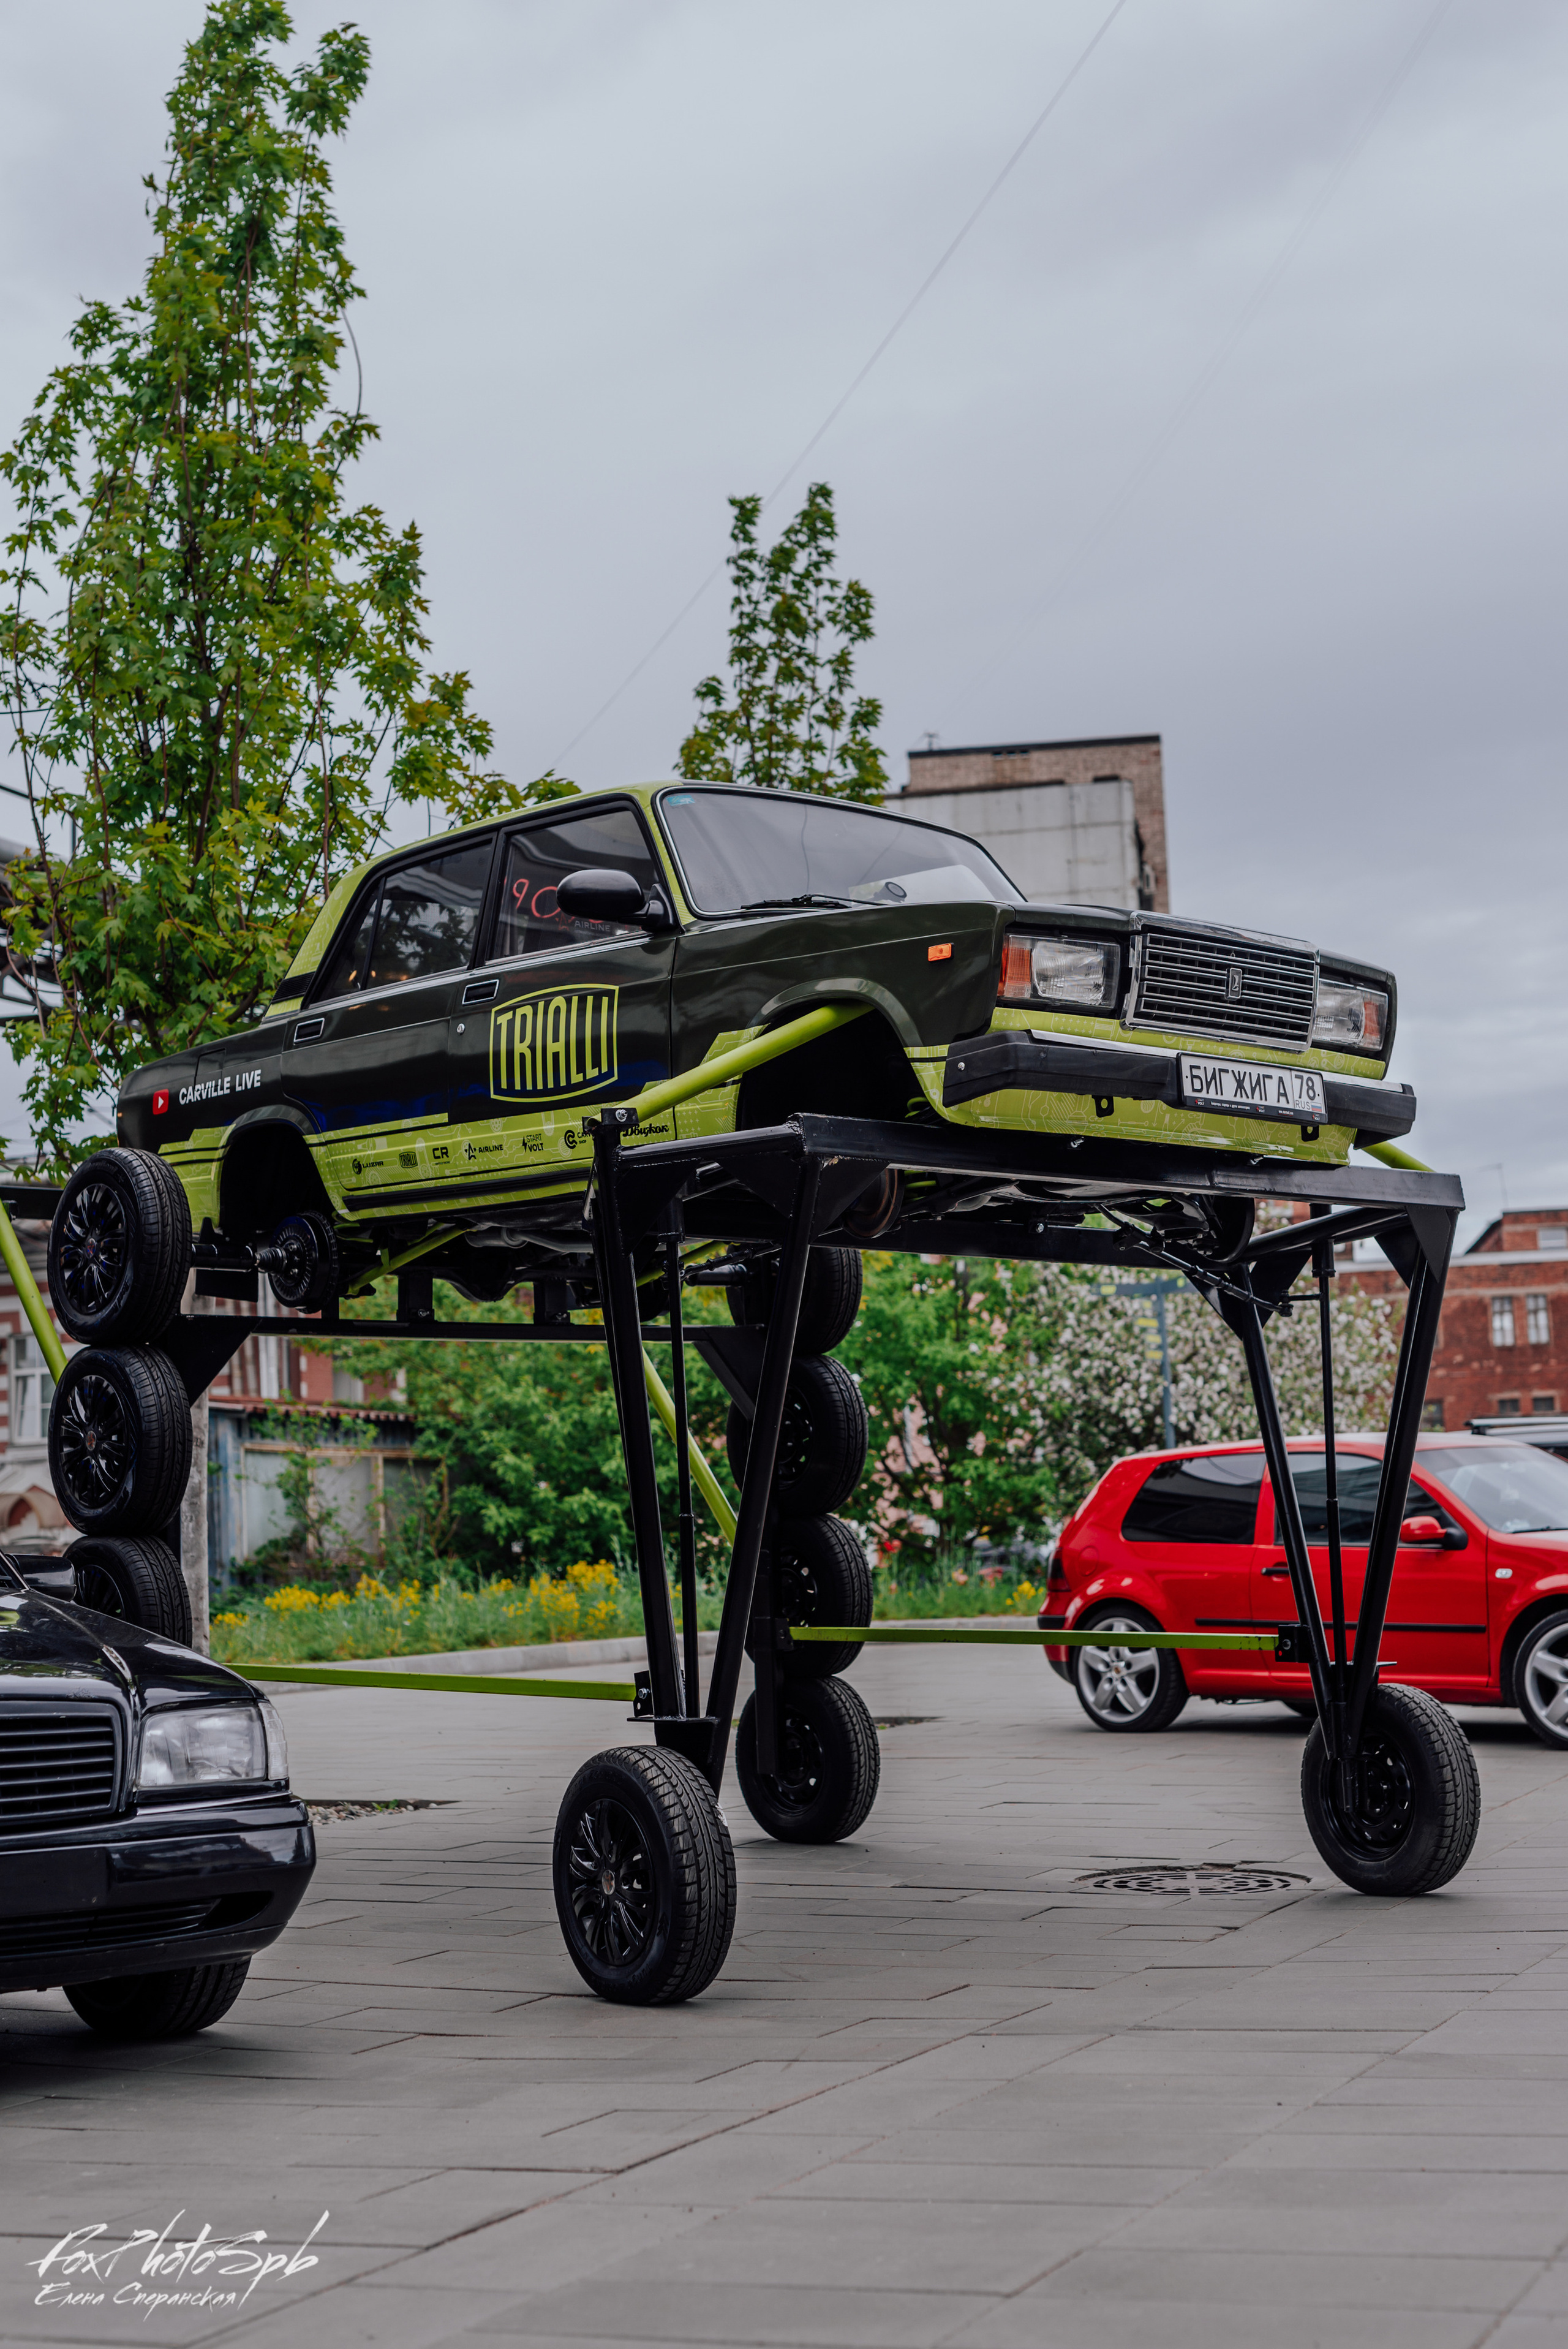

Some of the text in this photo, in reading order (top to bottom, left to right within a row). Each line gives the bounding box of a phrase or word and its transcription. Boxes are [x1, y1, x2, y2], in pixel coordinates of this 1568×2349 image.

[575, 920, 611, 932] AIRLINE
[496, 995, 609, 1091] TRIALLI
[179, 1069, 262, 1105] CARVILLE LIVE
[1295, 1075, 1316, 1100] 78
[1295, 1099, 1311, 1110] RUS
[526, 1133, 542, 1143] START
[432, 1146, 450, 1160] CR
[478, 1144, 503, 1154] AIRLINE
[527, 1143, 544, 1152] VOLT
[362, 1160, 384, 1169] LUZAR
[399, 1153, 417, 1167] TRIALLI
